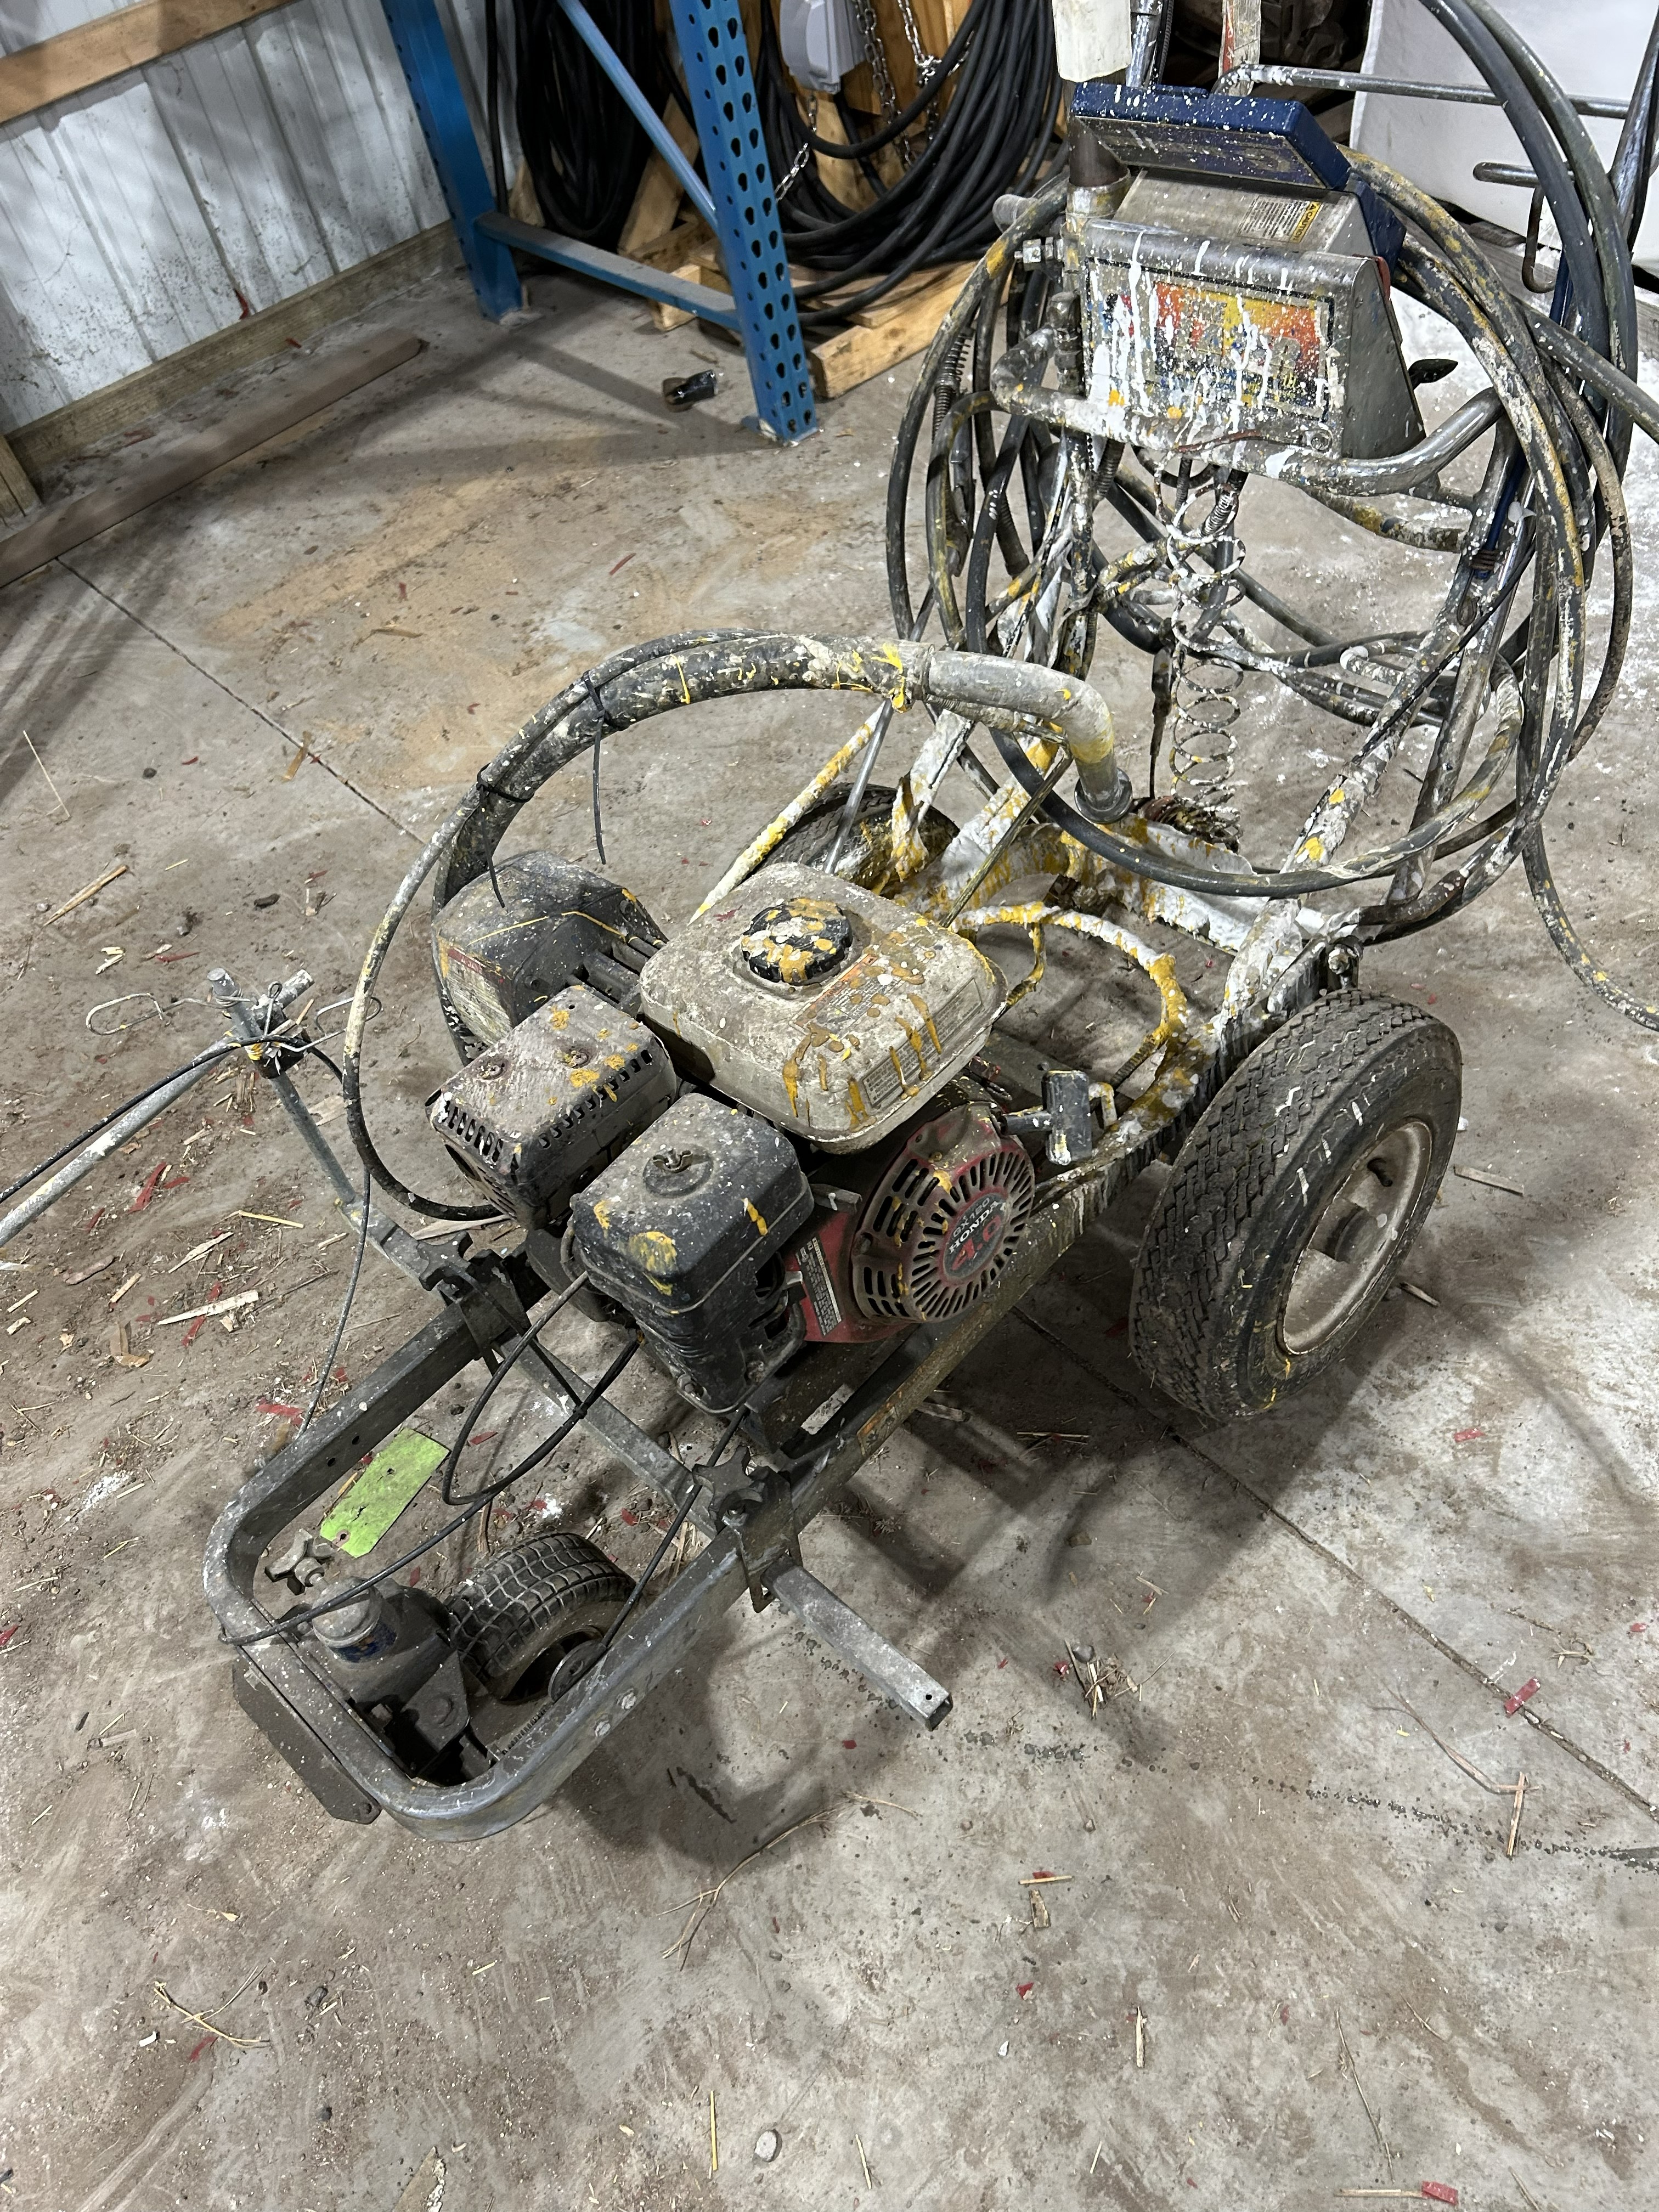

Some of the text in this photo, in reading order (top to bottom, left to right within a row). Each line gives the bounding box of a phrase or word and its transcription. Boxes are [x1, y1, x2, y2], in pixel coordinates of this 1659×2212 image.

[1293, 211, 1313, 241] CAUTION
[949, 1200, 1000, 1254] HONDA
[951, 1214, 1001, 1271] 4.0
